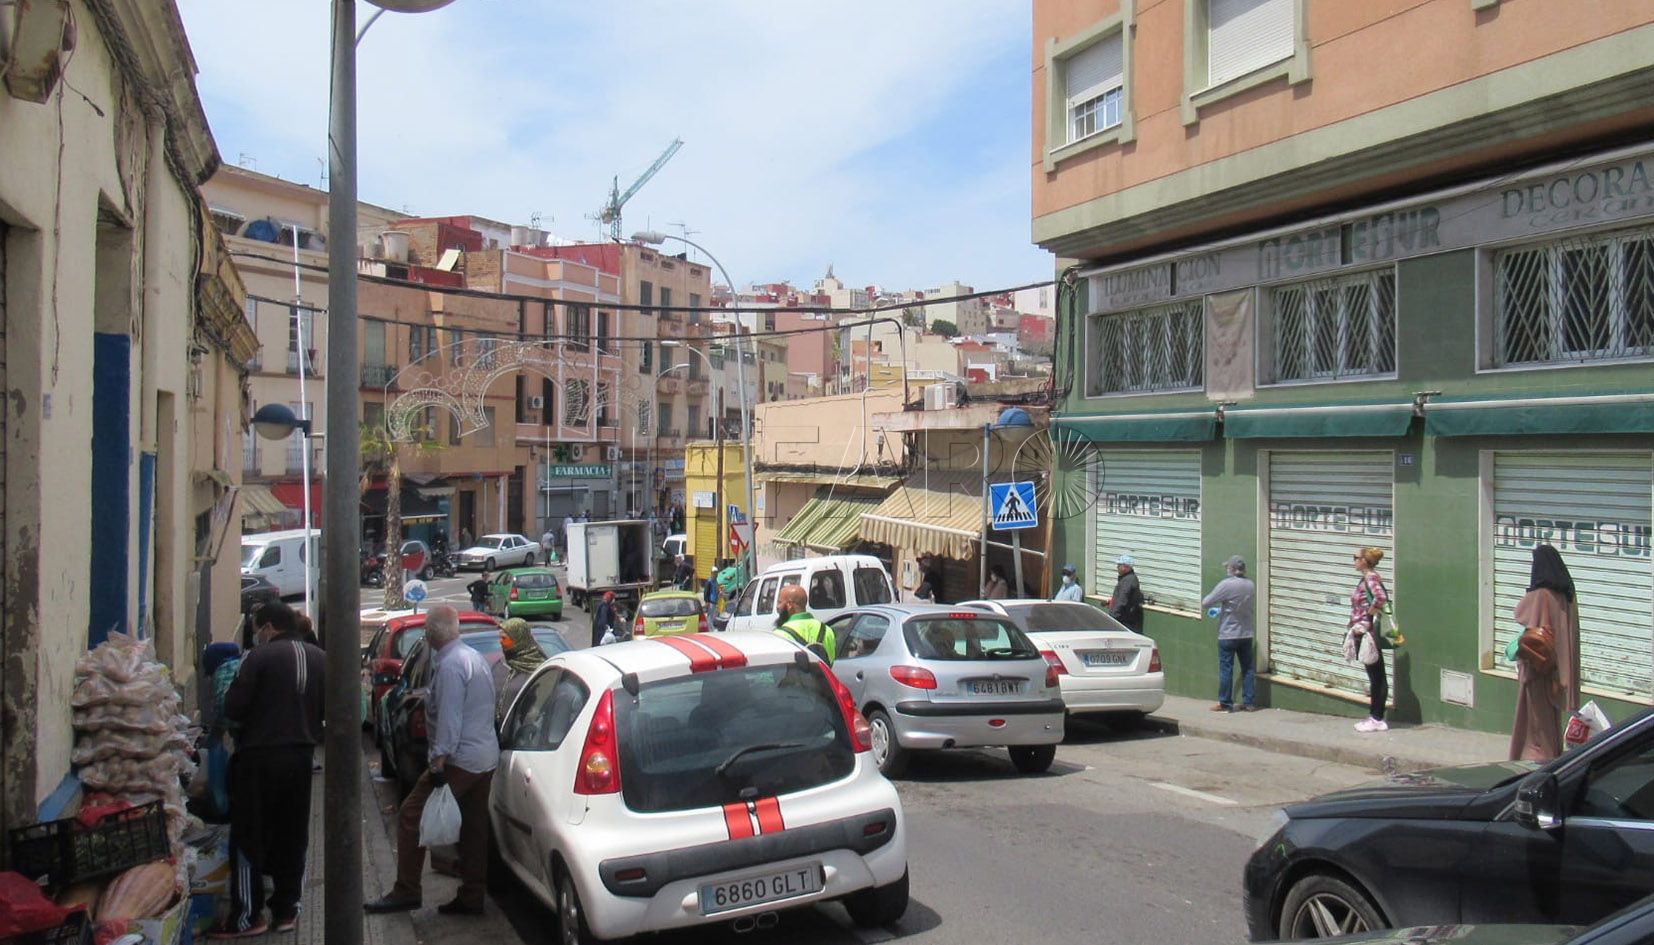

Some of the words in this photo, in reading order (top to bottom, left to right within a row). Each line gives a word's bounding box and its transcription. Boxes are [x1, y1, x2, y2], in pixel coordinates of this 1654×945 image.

[555, 466, 605, 476] FARMACIA
[715, 879, 767, 906] 6860
[772, 870, 808, 895] GLT
